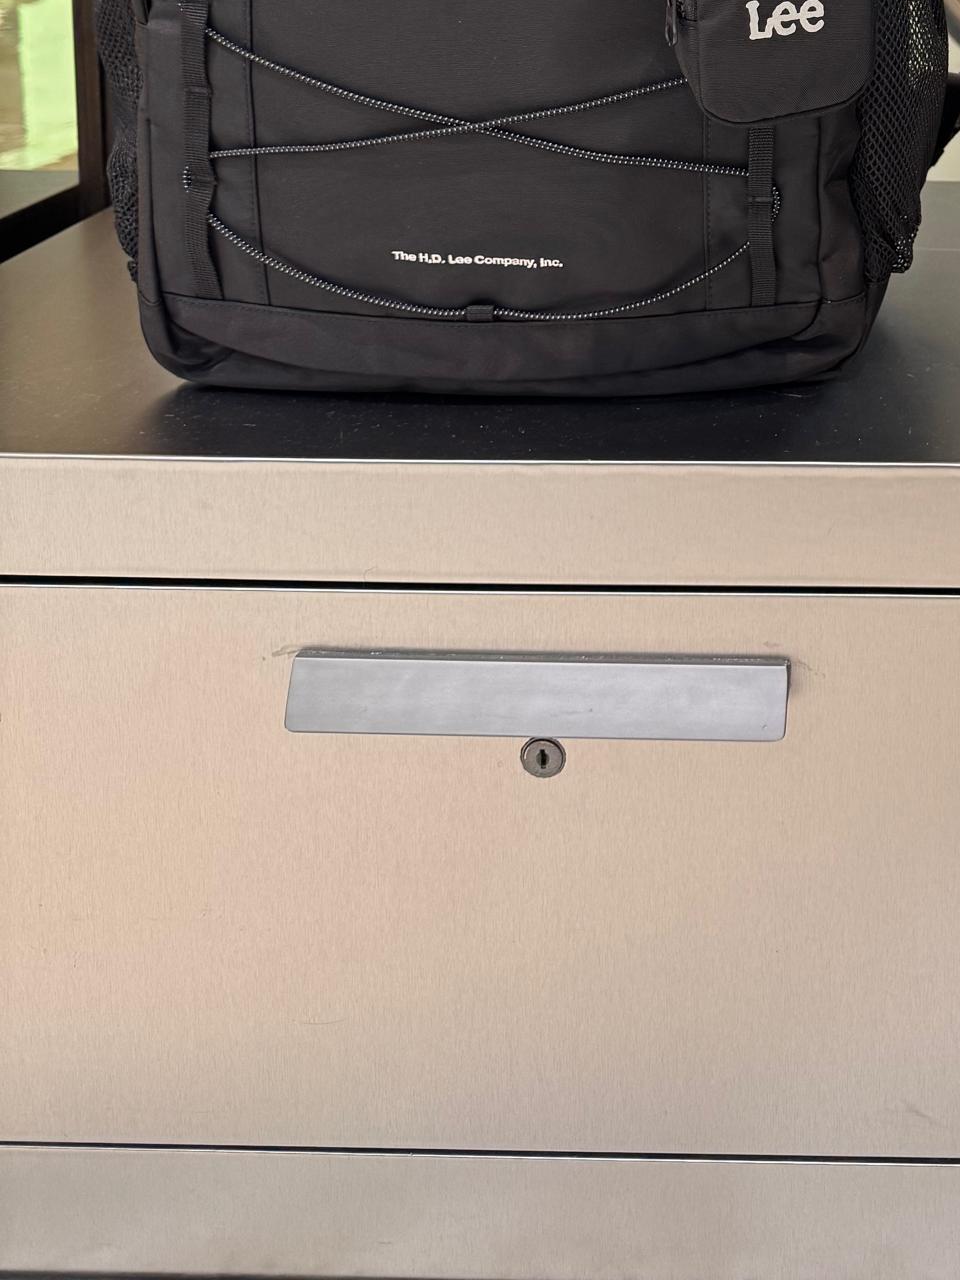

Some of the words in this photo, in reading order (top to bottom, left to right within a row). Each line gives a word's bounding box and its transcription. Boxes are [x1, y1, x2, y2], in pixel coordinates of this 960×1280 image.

[391, 250, 417, 262] The
[418, 252, 446, 264] H.D.
[447, 254, 473, 265] Lee
[473, 255, 538, 269] Company,
[539, 257, 564, 268] Inc.
